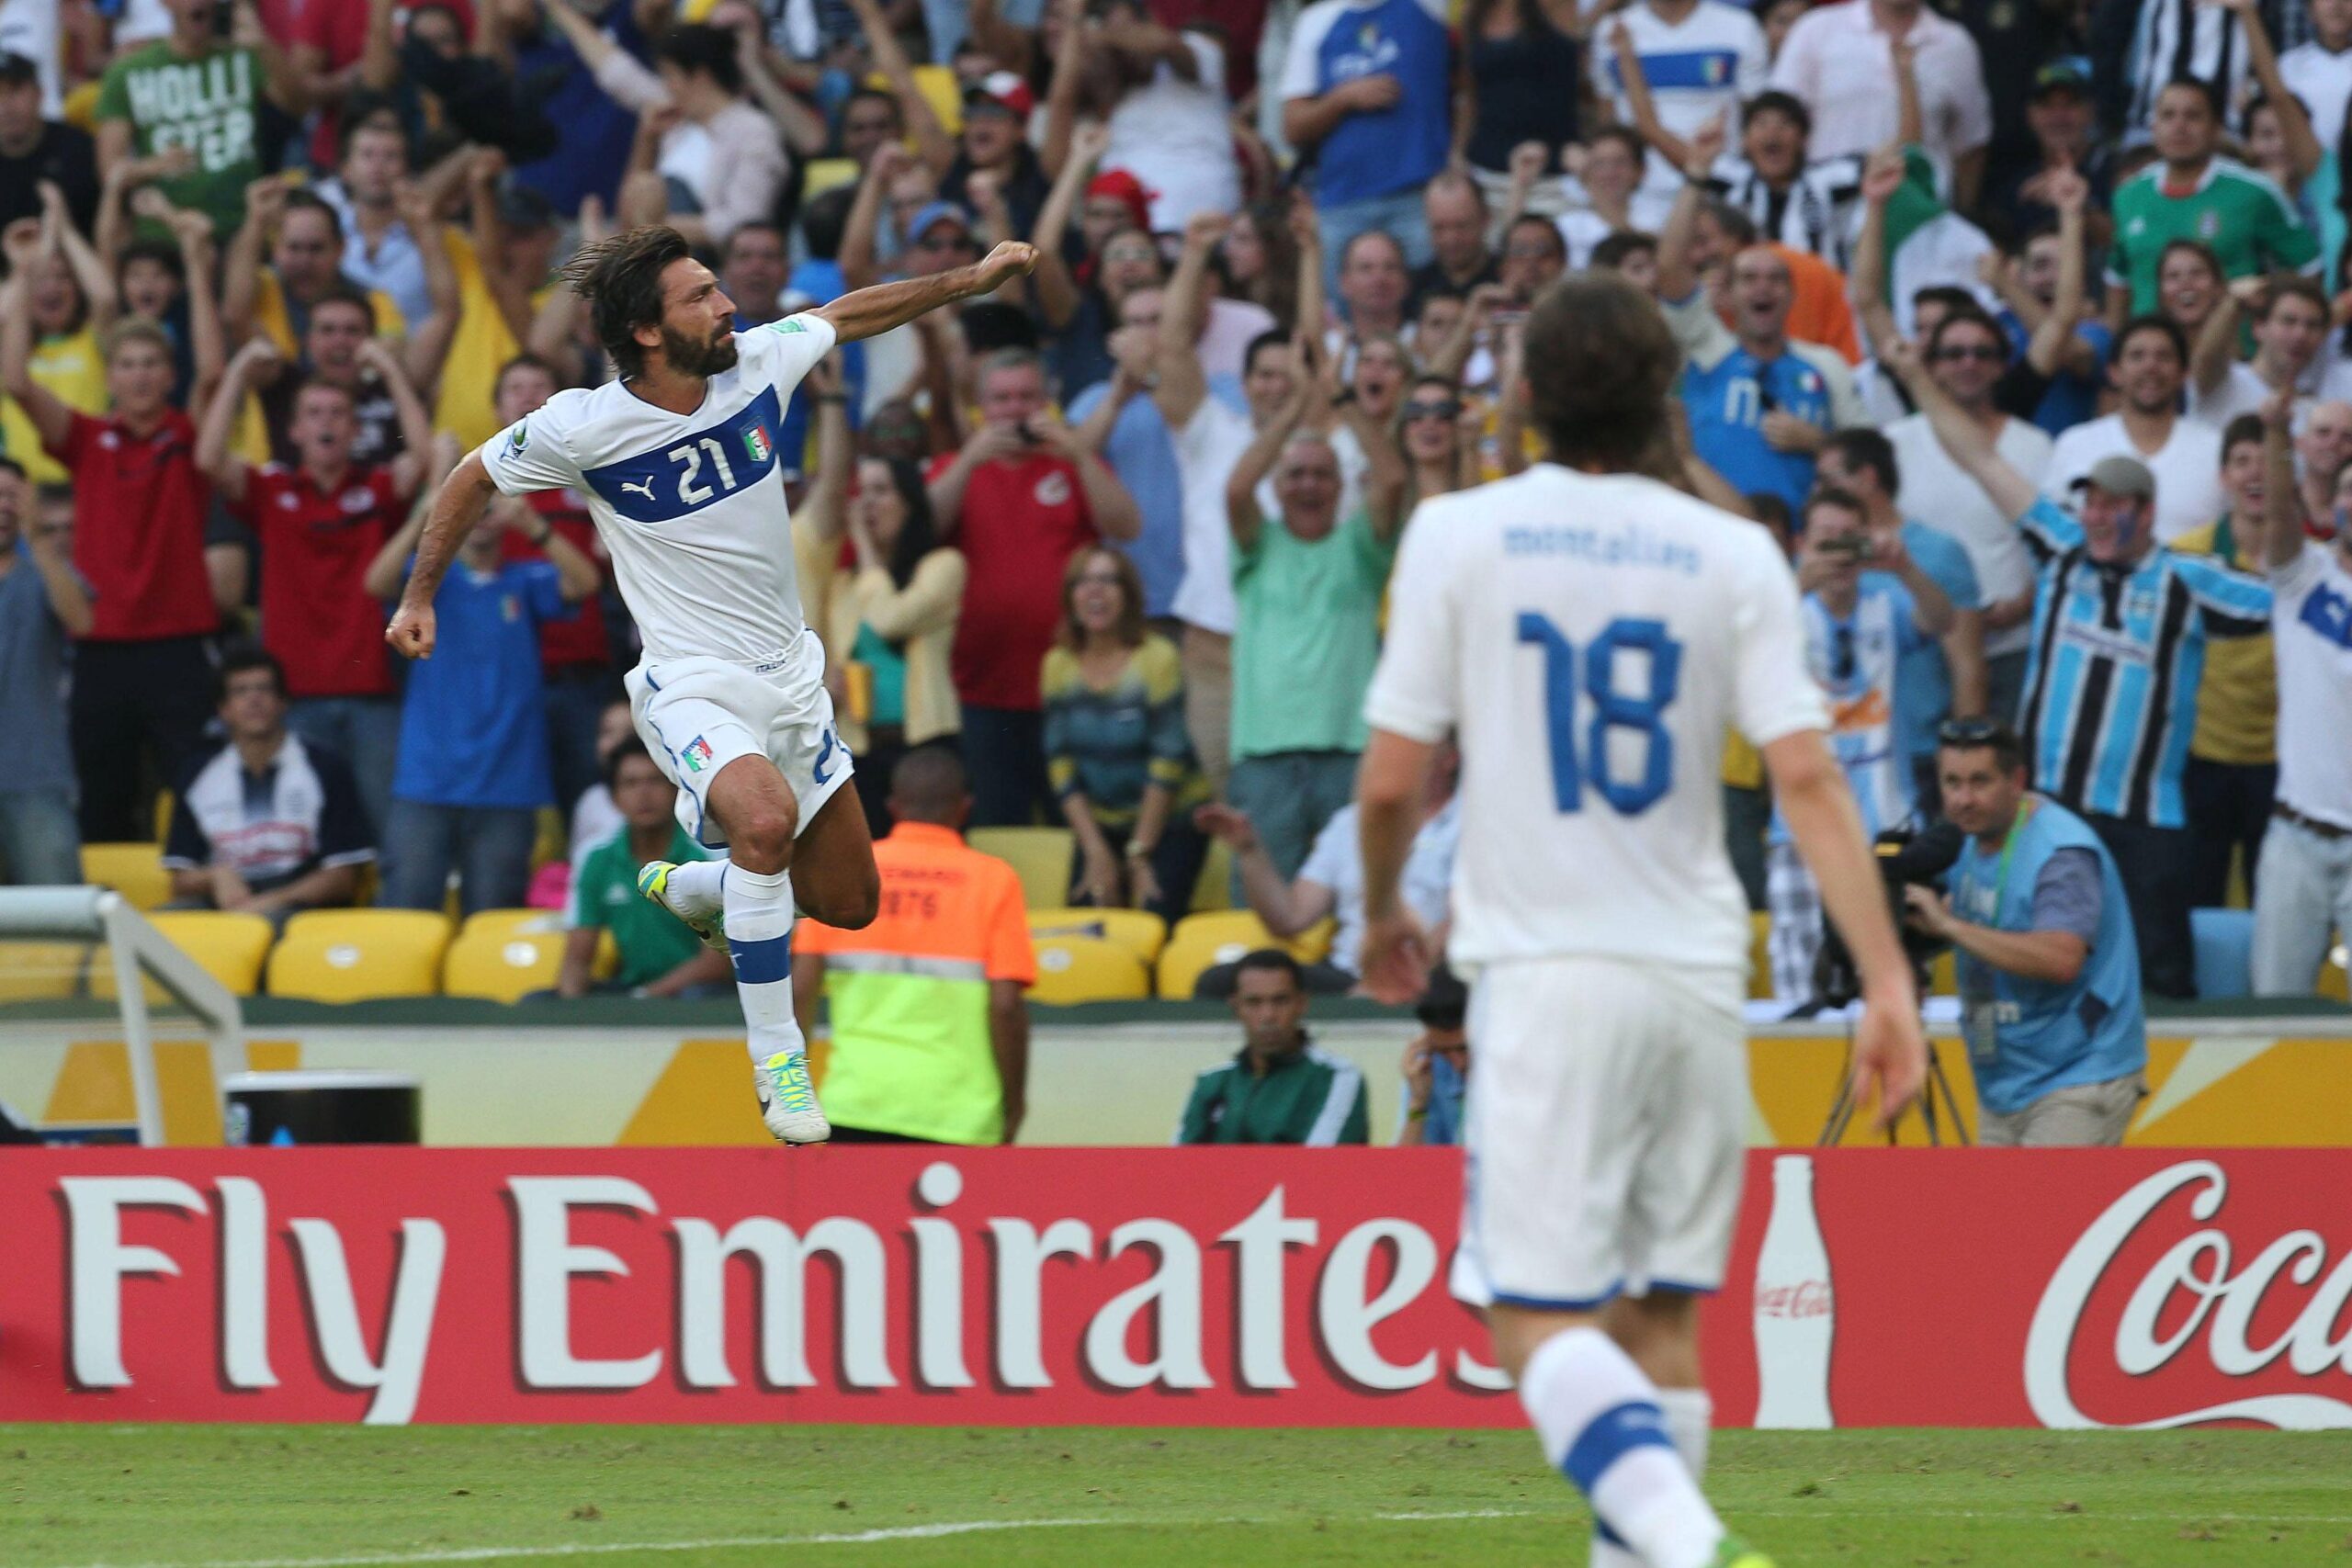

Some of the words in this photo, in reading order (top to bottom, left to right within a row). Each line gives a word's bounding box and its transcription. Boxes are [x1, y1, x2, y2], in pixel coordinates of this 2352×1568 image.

[127, 51, 253, 127] HOLLI
[667, 437, 737, 505] 21
[1516, 610, 1683, 817] 18
[57, 1175, 447, 1425] Fly
[505, 1161, 1516, 1390] Emirate
